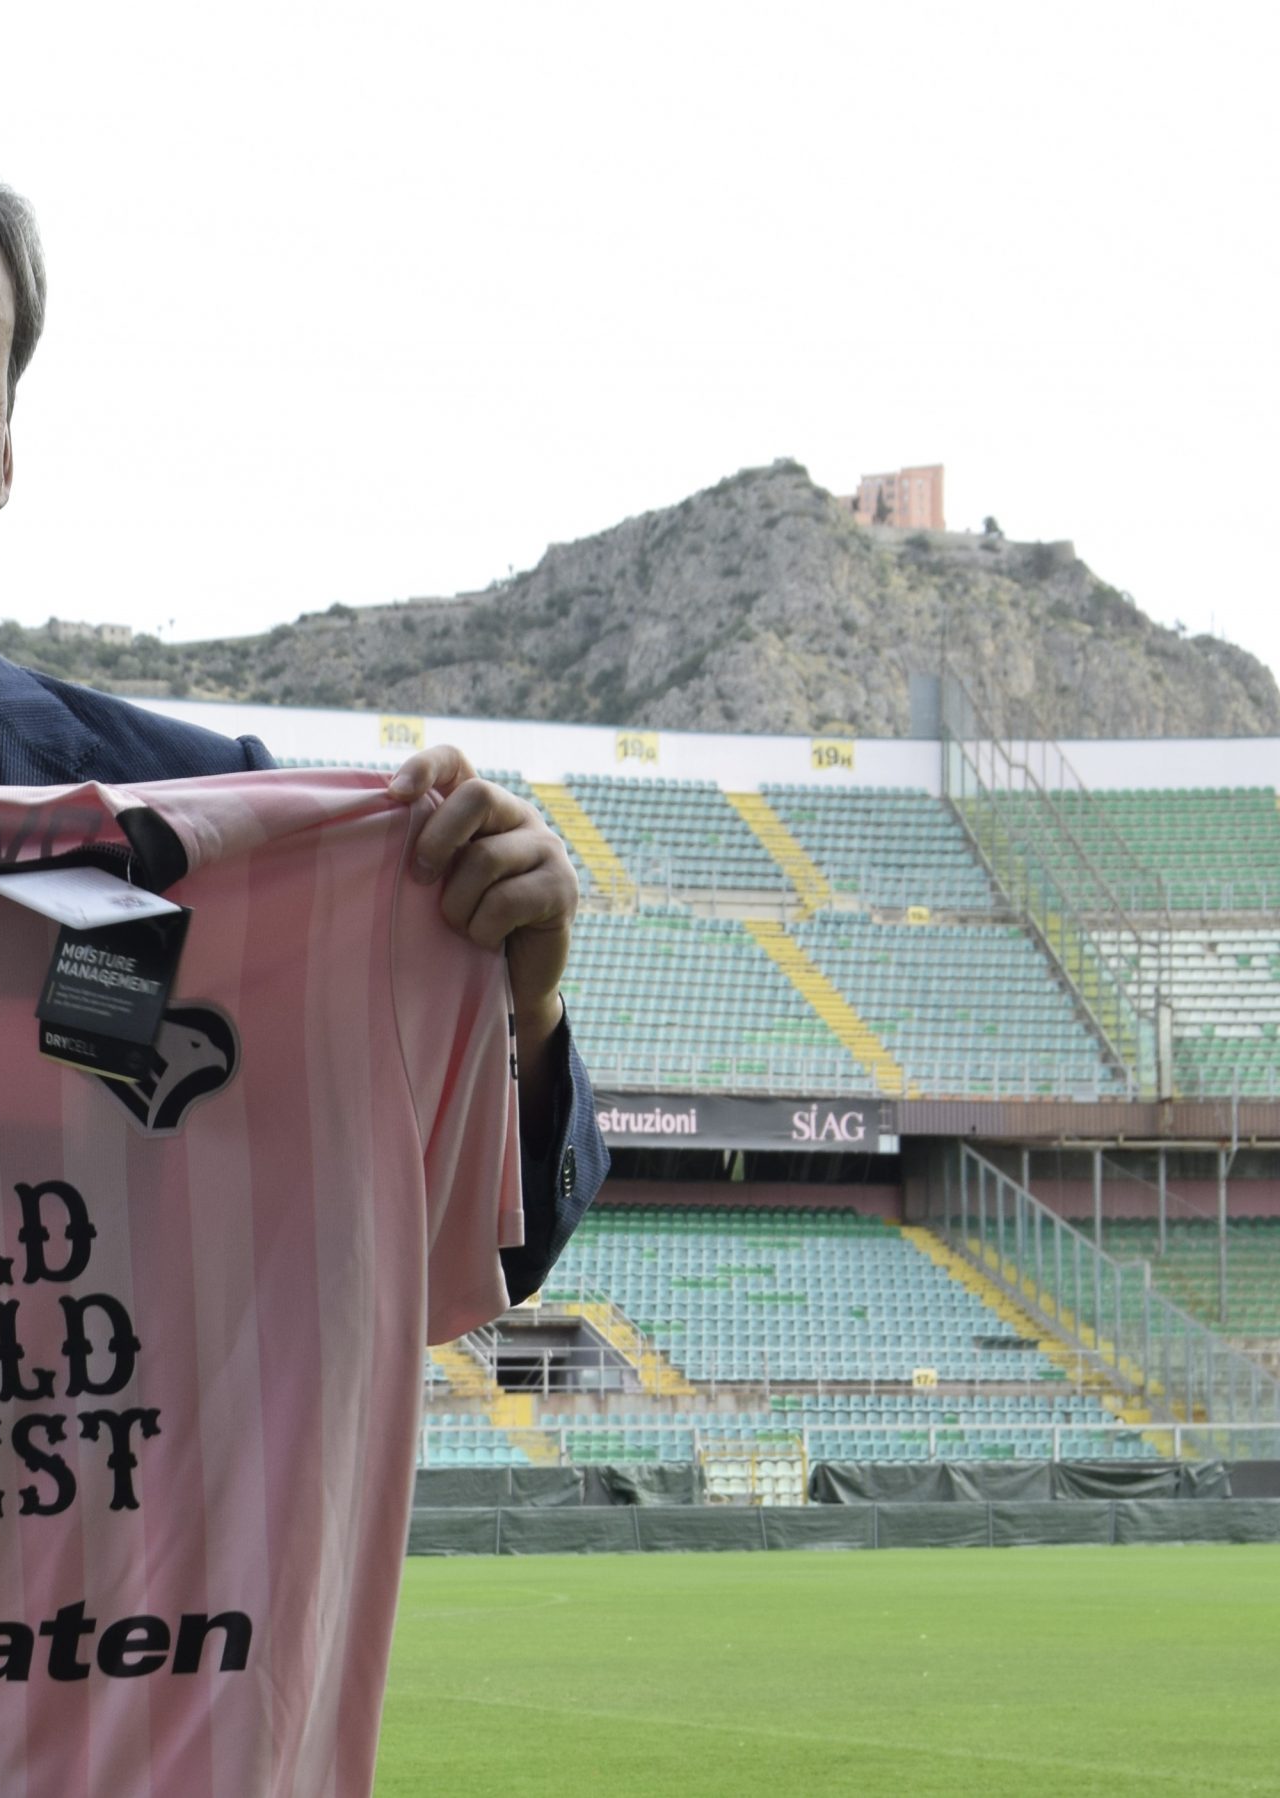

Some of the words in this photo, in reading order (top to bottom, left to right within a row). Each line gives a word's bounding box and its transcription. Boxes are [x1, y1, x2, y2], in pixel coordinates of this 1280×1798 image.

[61, 941, 138, 974] MOISTURE
[56, 959, 164, 996] MANAGEMENT
[596, 1107, 697, 1135] struzioni
